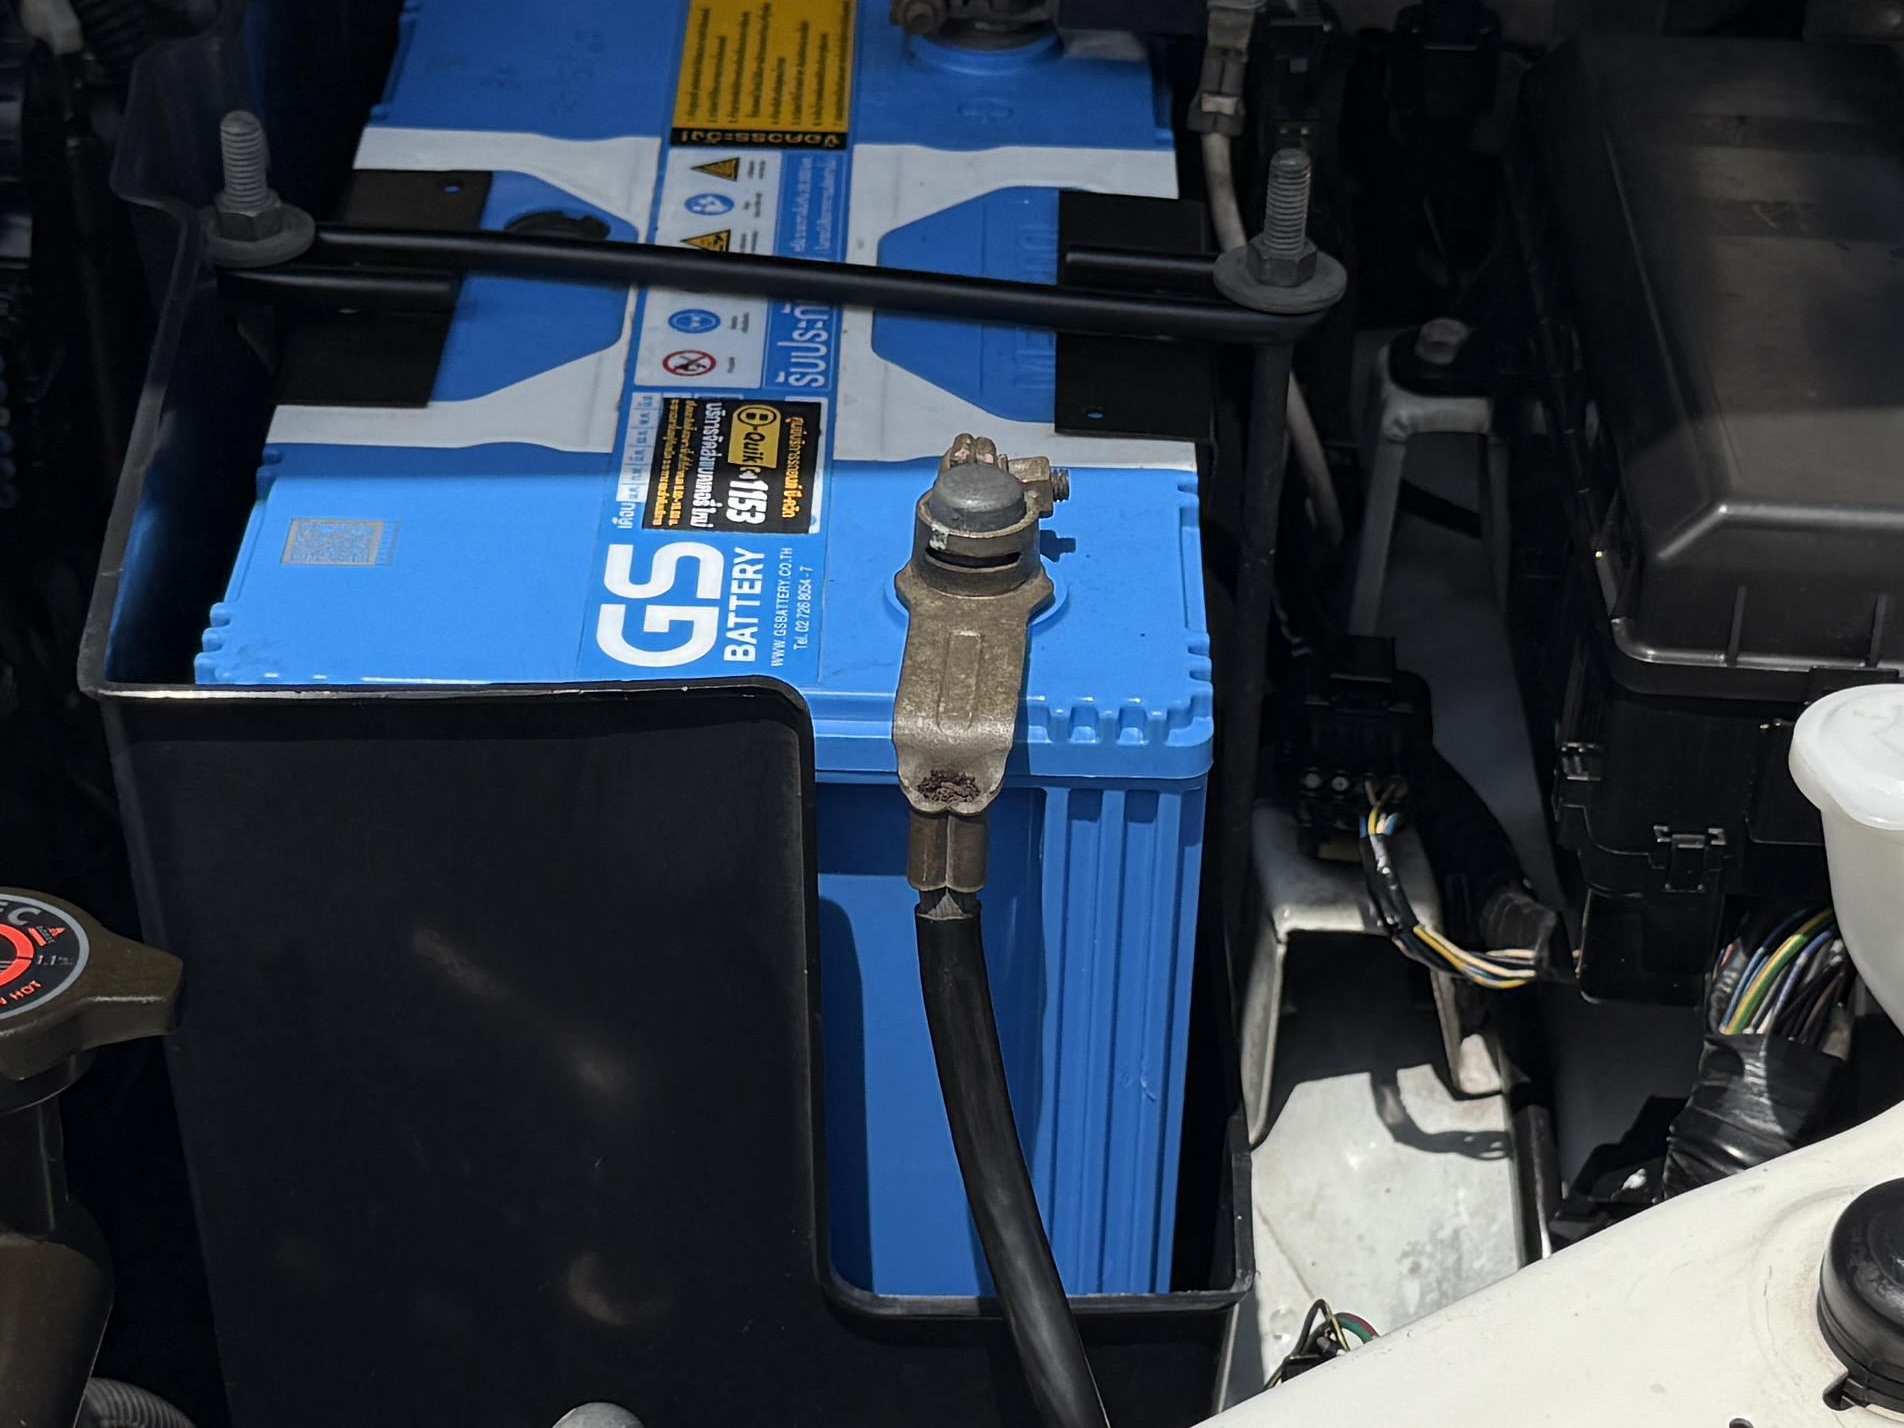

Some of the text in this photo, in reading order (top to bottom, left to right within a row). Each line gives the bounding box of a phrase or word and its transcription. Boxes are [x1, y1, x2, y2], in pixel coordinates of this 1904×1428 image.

[725, 480, 769, 524] 1153
[596, 541, 725, 668] GS
[724, 546, 765, 663] BATTERY
[770, 547, 794, 667] WWW.GSBATTERY.CO.TH
[794, 633, 809, 651] Tel.
[10, 979, 43, 1000] HOT
